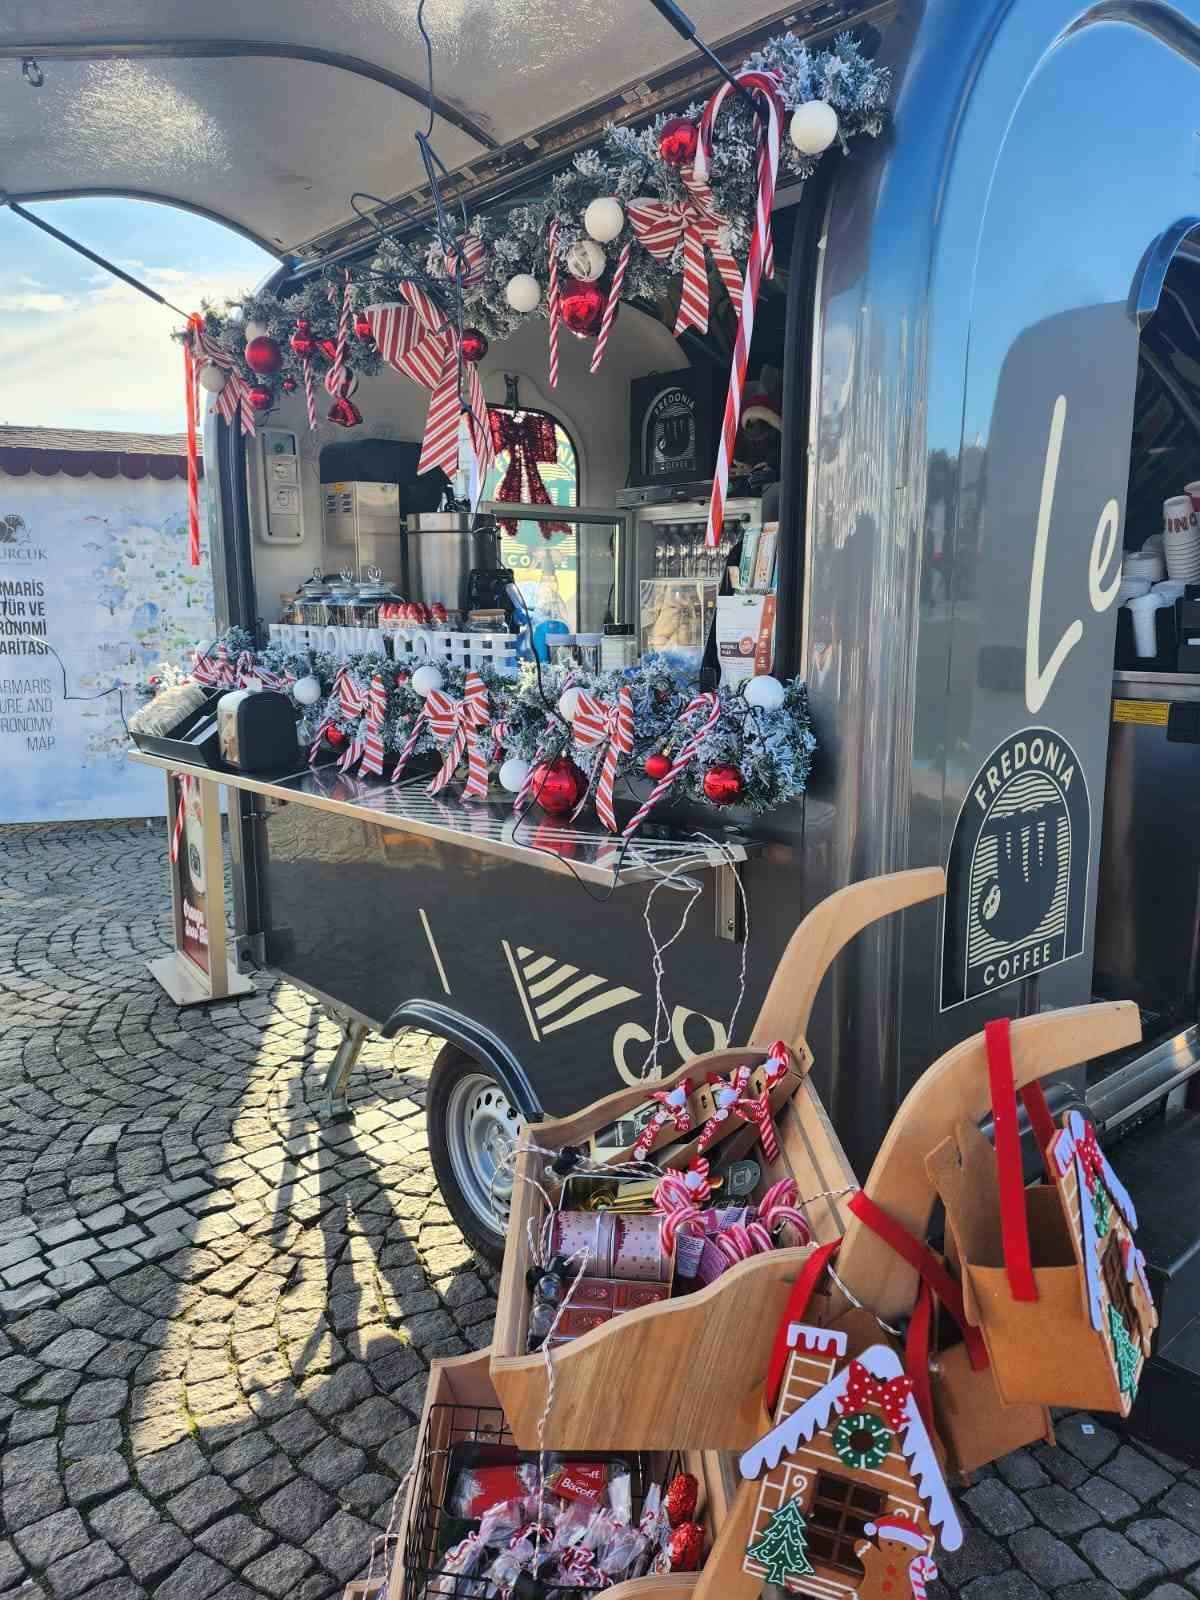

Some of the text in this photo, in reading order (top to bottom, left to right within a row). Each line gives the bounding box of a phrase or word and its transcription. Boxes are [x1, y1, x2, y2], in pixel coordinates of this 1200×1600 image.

[1025, 394, 1123, 714] Le
[29, 600, 45, 616] VE
[27, 698, 53, 713] AND
[26, 735, 56, 752] MAP
[973, 737, 1075, 812] FREDONIA
[982, 942, 1051, 986] COFFEE
[561, 1478, 597, 1498] Biscoff
